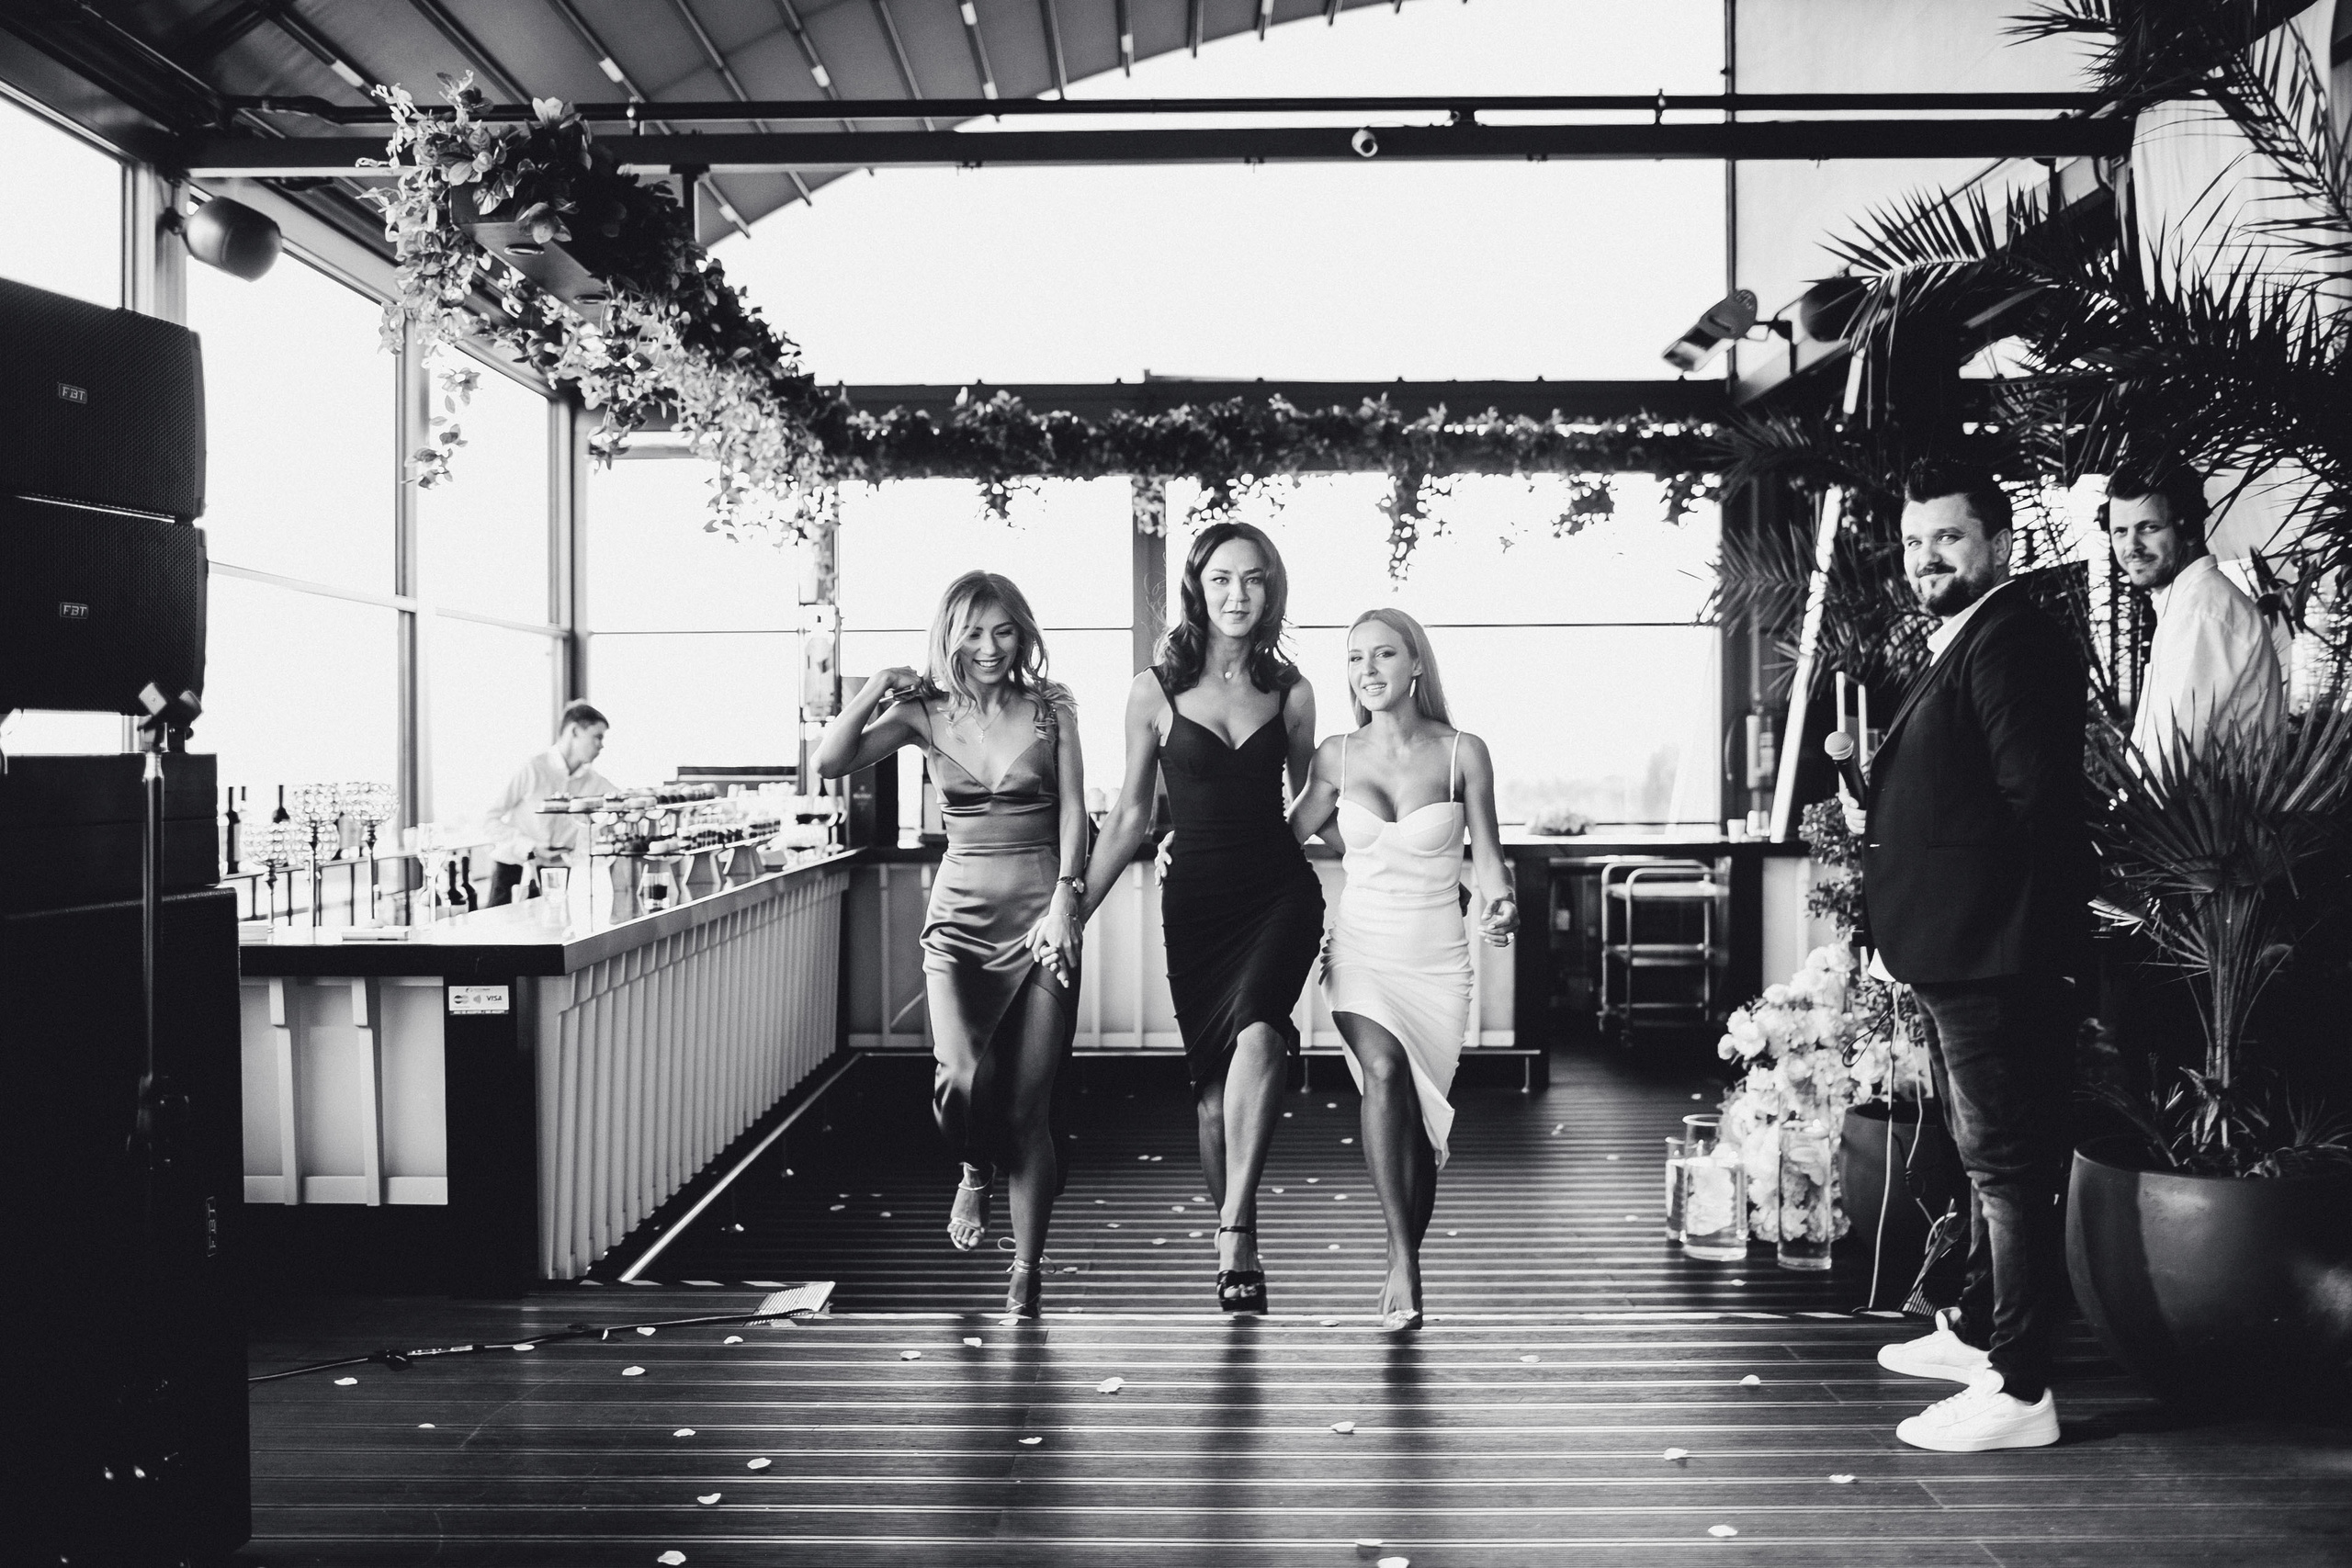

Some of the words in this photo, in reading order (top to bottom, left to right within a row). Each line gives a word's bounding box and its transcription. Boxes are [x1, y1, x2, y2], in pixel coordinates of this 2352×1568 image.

[62, 386, 85, 400] FBT
[62, 604, 87, 616] FBT
[208, 1203, 217, 1250] FBT
